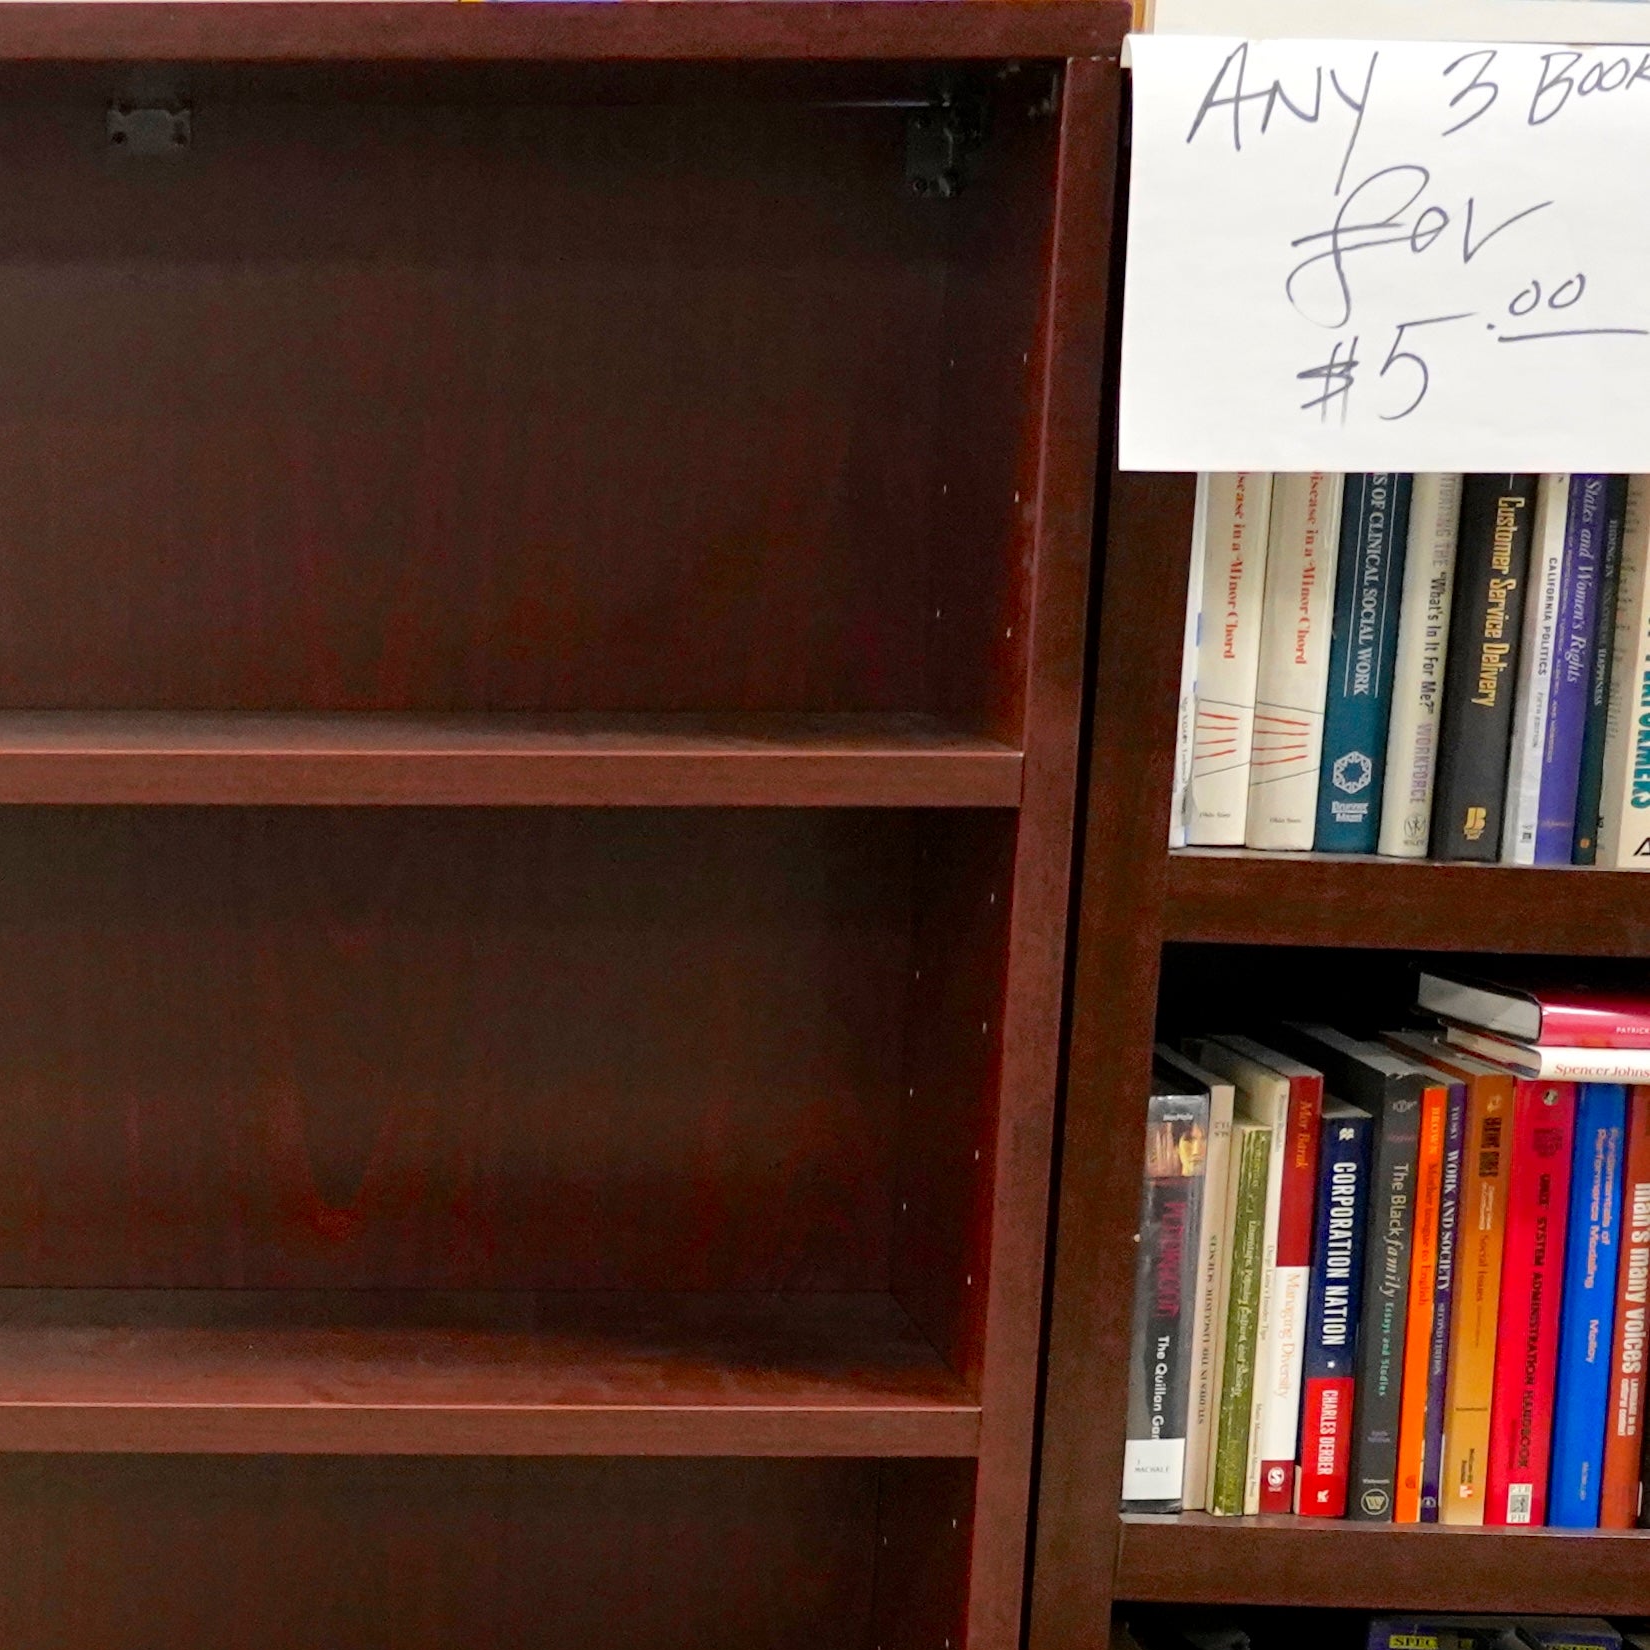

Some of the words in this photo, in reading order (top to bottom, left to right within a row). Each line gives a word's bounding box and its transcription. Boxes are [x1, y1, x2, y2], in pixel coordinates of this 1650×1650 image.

[1185, 41, 1379, 197] ANY
[1441, 50, 1499, 137] 3
[1285, 165, 1555, 329] for
[1370, 486, 1387, 511] OF
[1581, 477, 1602, 524] States
[1363, 513, 1385, 586] CLINICAL
[1491, 496, 1526, 576] Customer
[1579, 528, 1592, 561] and
[1226, 554, 1244, 612] Minor
[1298, 559, 1317, 615] Minor
[1484, 578, 1517, 639] Service
[1543, 557, 1558, 622] CALIFORNIA
[1572, 565, 1595, 631] Women's
[1223, 612, 1239, 660] Chord
[1294, 615, 1311, 665] Chord
[1357, 587, 1380, 645] SOCIAL
[1426, 624, 1442, 638] In
[1352, 646, 1376, 696] WORK
[1421, 655, 1440, 677] For
[1424, 640, 1441, 653] It
[1537, 626, 1552, 677] POLITICS
[1564, 634, 1588, 684] Rights
[1418, 681, 1437, 714] Me?"
[1471, 642, 1511, 708] Delivery
[1408, 722, 1434, 804] WORKFORCE
[1554, 1064, 1610, 1076] Spencer
[1299, 1100, 1313, 1132] Mor
[1430, 1106, 1441, 1154] BROWN
[1294, 1133, 1310, 1168] Barak
[1444, 1150, 1460, 1195] WORK
[1590, 1128, 1608, 1222] Performance
[1390, 1163, 1410, 1192] The
[1602, 1127, 1619, 1227] Fundamentals
[1325, 1161, 1357, 1279] CORPORATION
[1442, 1199, 1455, 1227] AND
[1437, 1229, 1454, 1292] SOCIETY
[1534, 1216, 1548, 1267] SYSTEM
[1625, 1248, 1650, 1302] many
[1278, 1272, 1297, 1342] Managing
[1321, 1285, 1349, 1346] NATION
[1525, 1272, 1544, 1386] ADMINISTRATION
[1157, 1335, 1170, 1360] The
[1621, 1307, 1645, 1374] voices
[1153, 1362, 1169, 1413] Quillan
[1274, 1343, 1296, 1399] Diversity
[1319, 1389, 1340, 1435] CHARLES
[1518, 1389, 1533, 1469] HANDBOOK
[1316, 1436, 1336, 1476] DERBER
